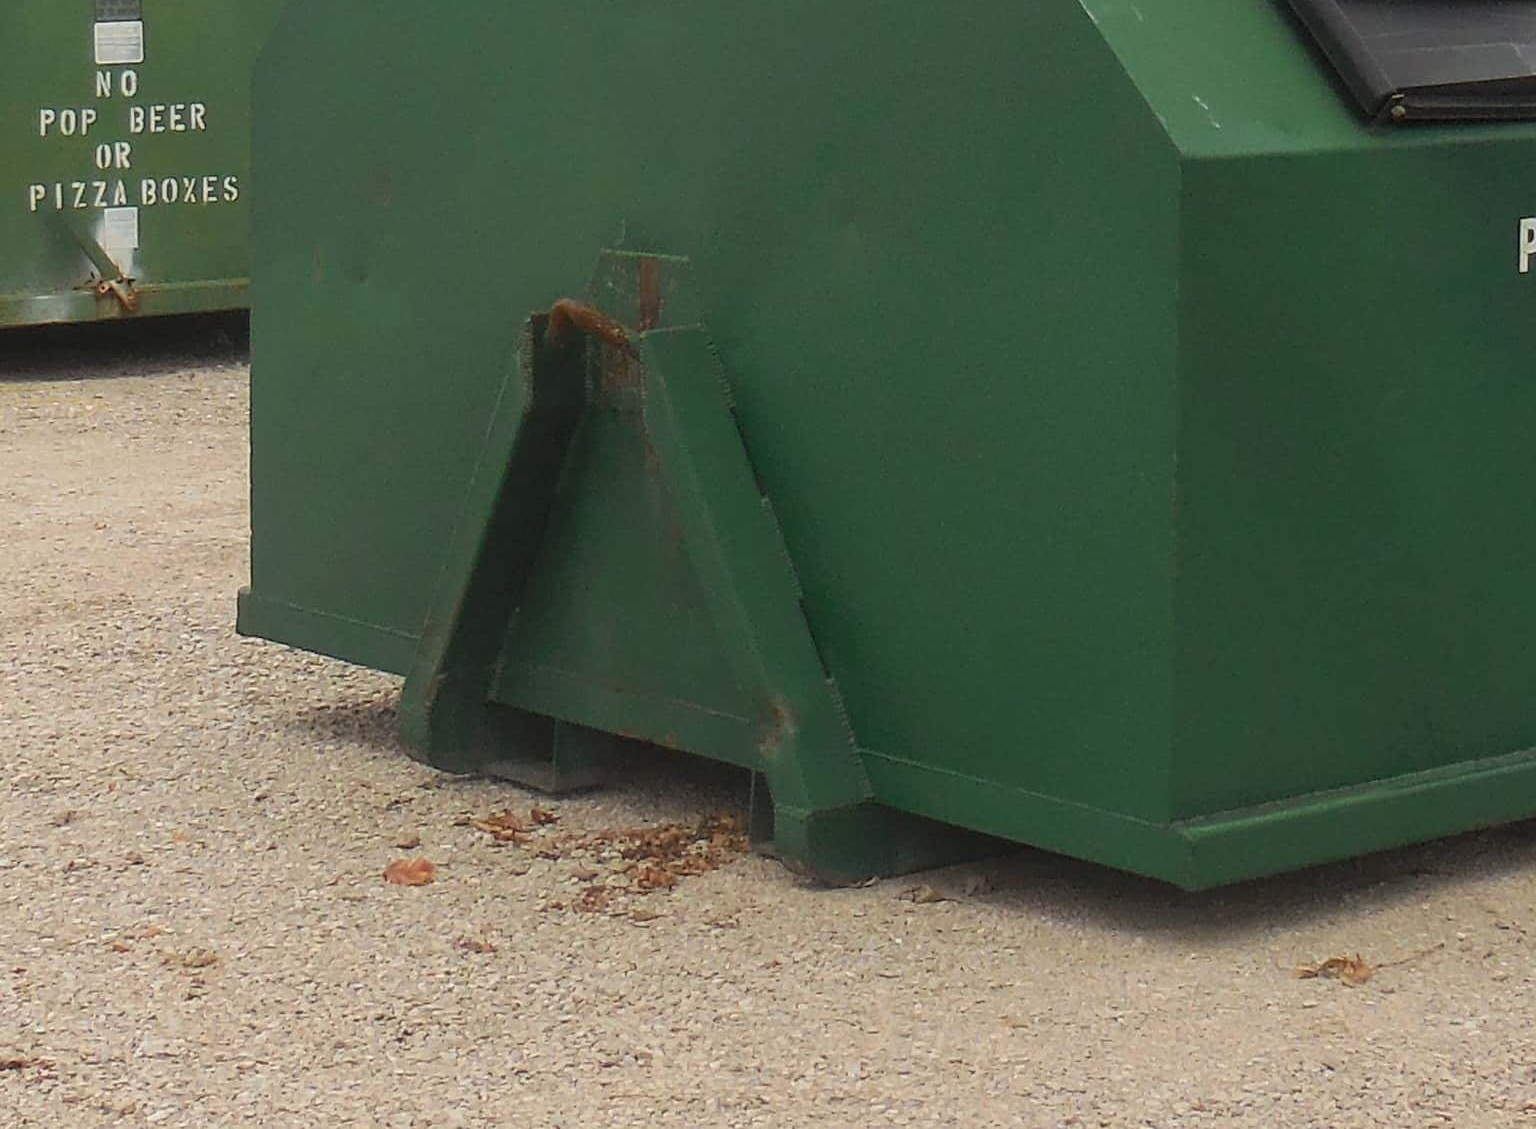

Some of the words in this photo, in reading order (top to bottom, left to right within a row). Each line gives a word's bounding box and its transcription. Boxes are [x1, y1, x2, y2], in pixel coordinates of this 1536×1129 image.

[96, 69, 138, 98] NO
[40, 108, 97, 137] POP
[129, 103, 206, 133] BEER
[95, 141, 132, 169] OR
[29, 178, 128, 211] PIZZA
[141, 176, 239, 205] BOXES
